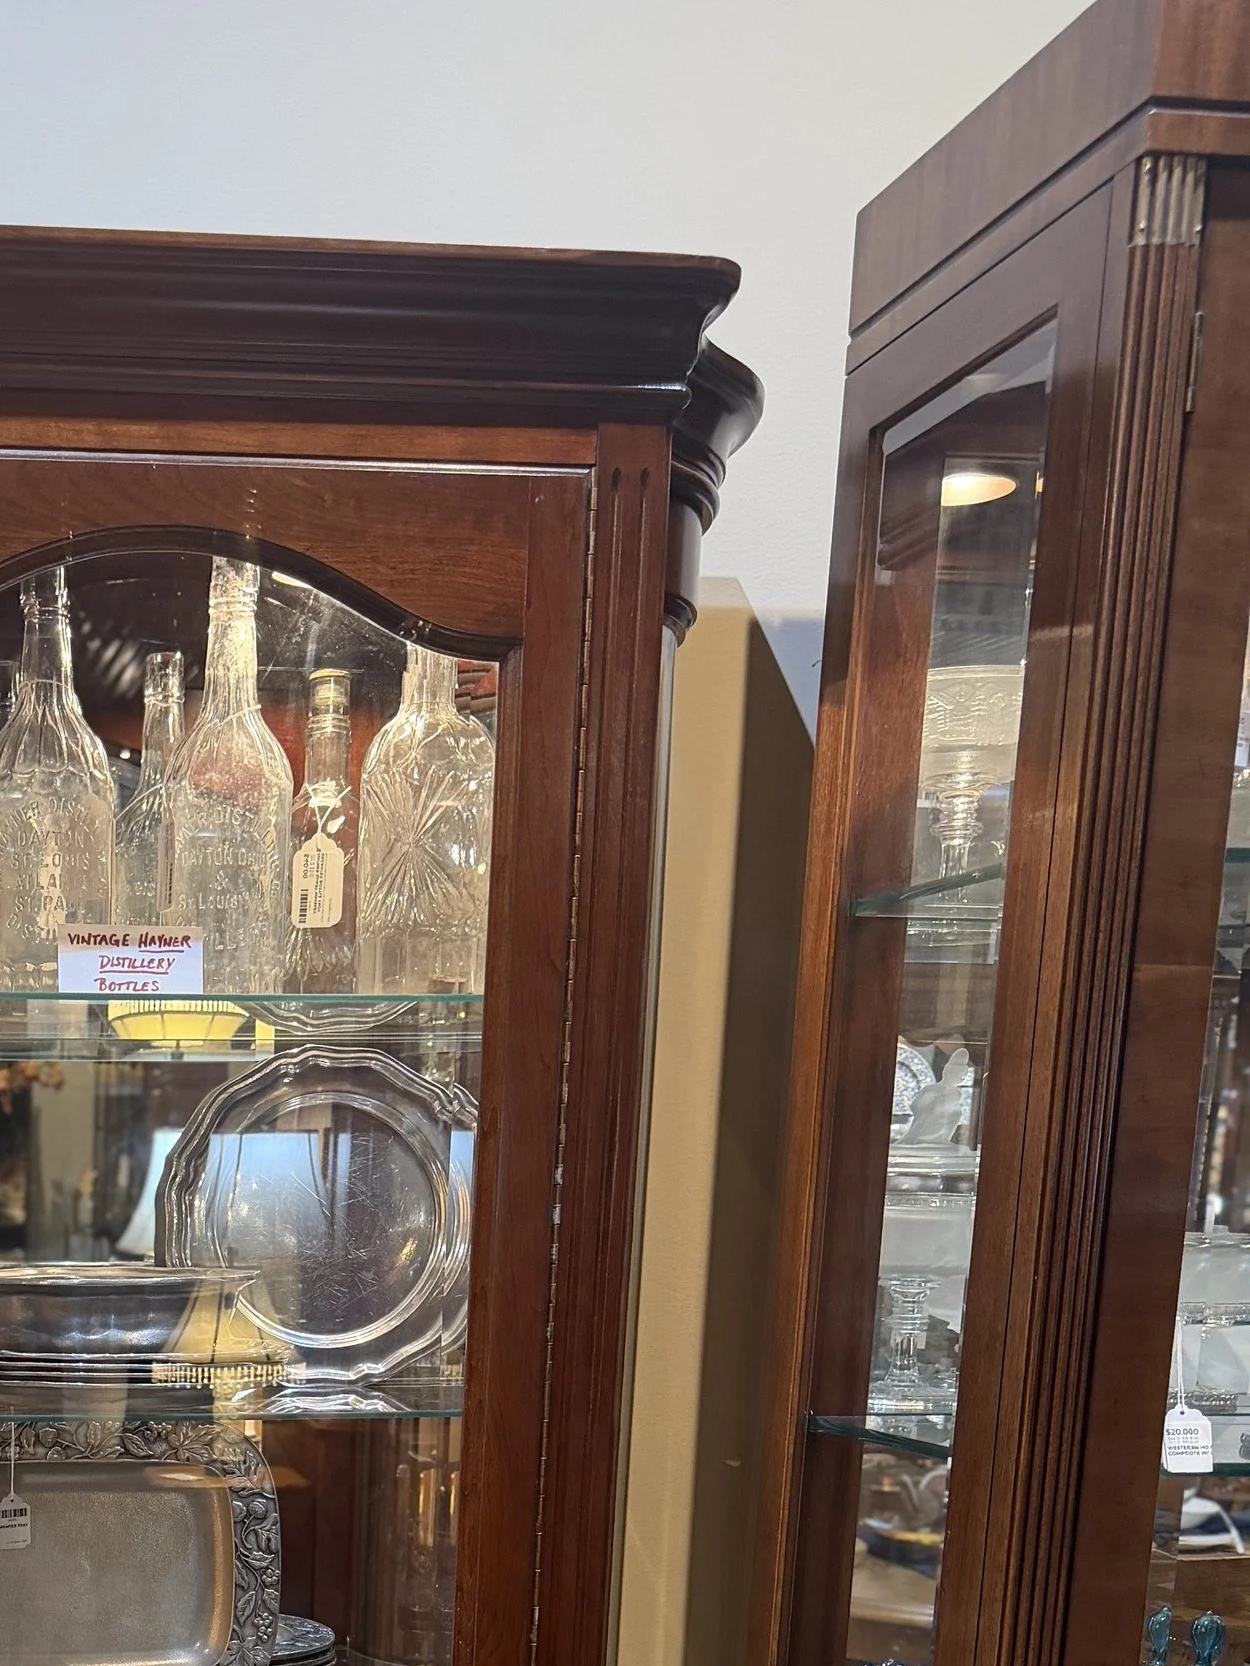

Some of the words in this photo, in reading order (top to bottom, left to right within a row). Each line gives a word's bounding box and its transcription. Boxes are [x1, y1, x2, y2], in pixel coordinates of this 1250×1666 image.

[67, 932, 130, 948] VINTAGE
[137, 932, 192, 949] HAYNER
[98, 954, 176, 973] DISTILLERY
[94, 977, 160, 992] BOTTLES
